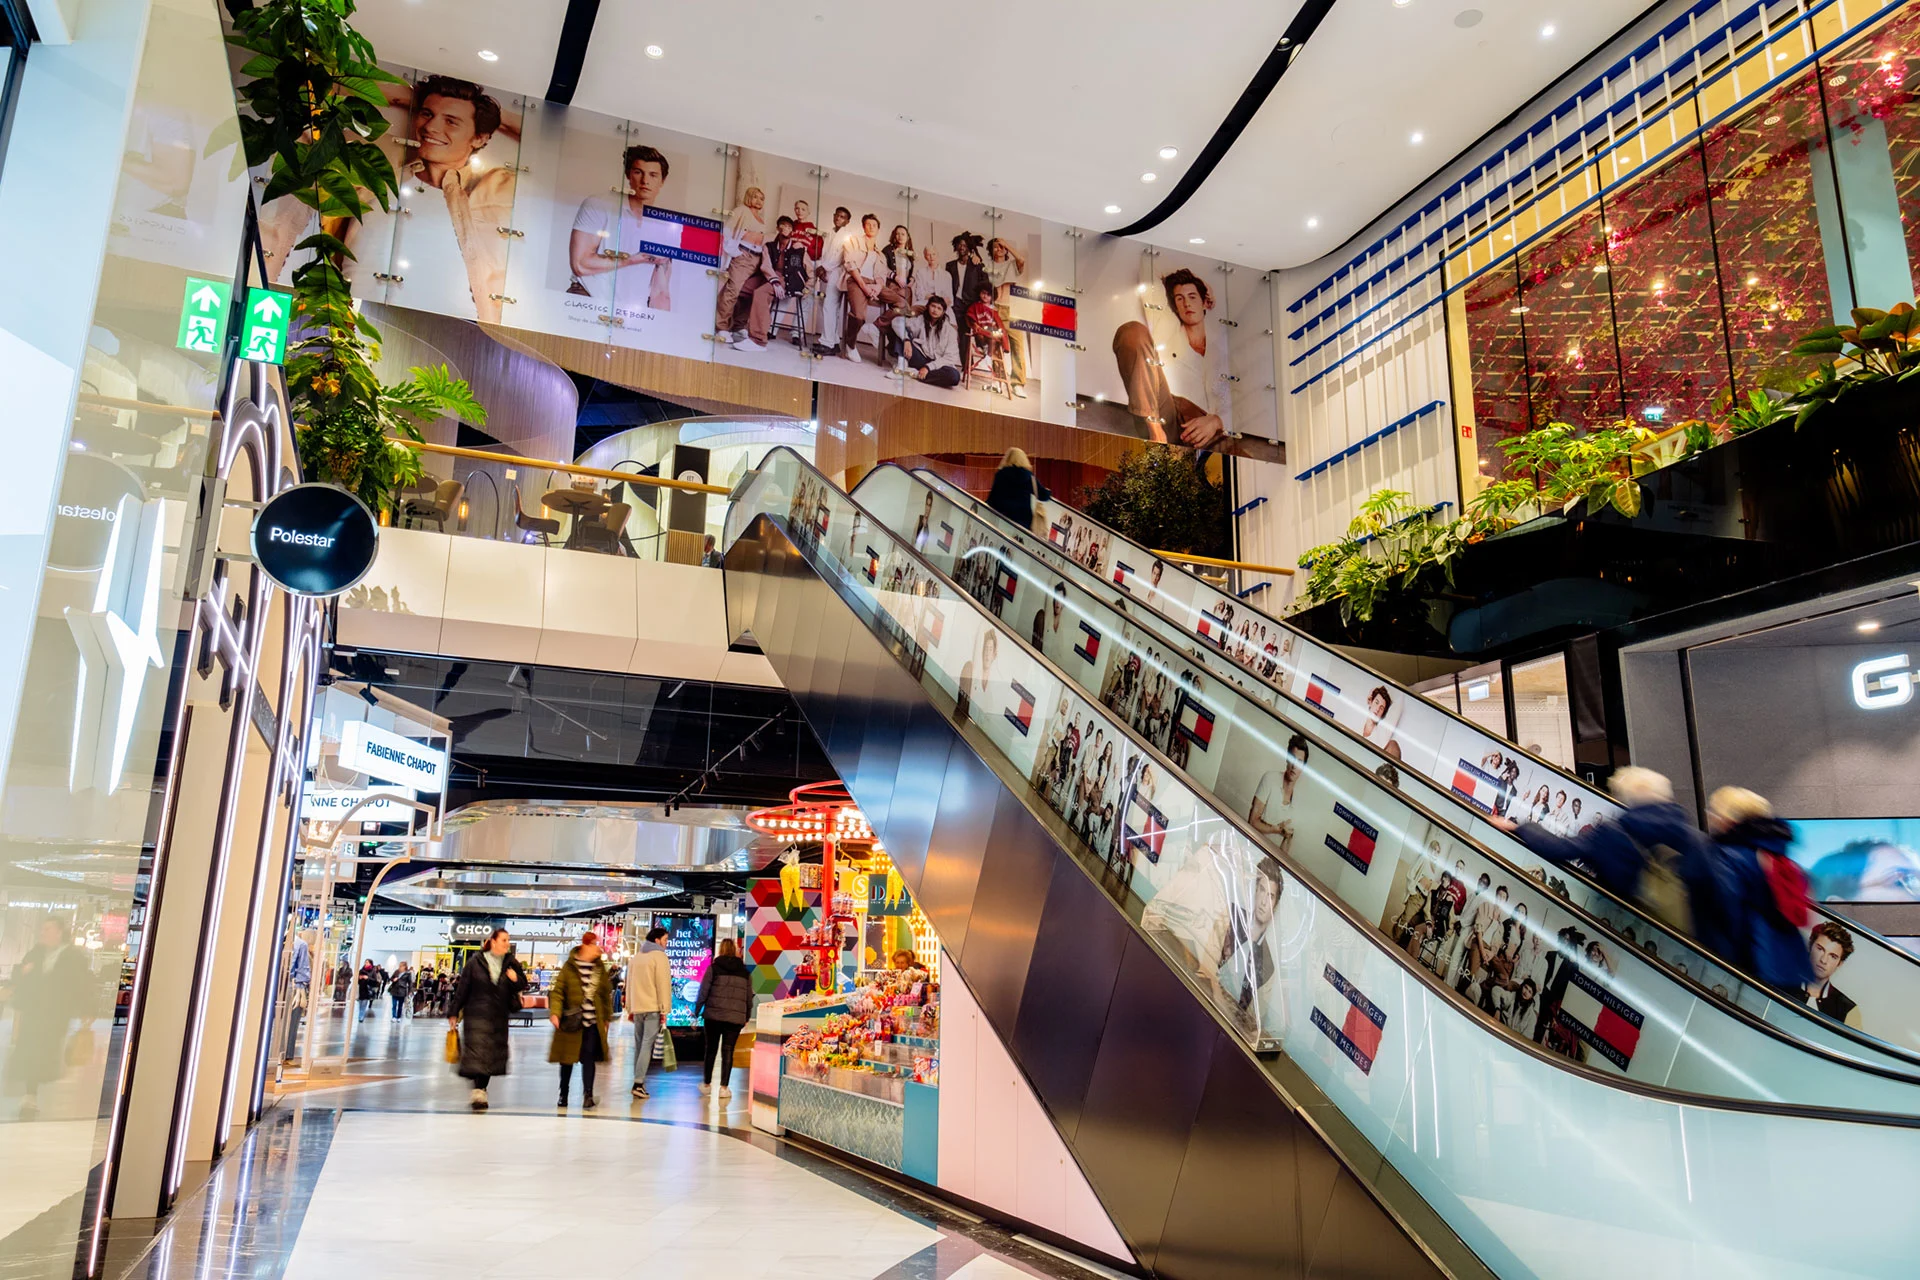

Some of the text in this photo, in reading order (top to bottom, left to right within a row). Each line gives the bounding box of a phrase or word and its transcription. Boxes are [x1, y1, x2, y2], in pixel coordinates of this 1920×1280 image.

[645, 207, 721, 230] TOMMY HILFIGER
[643, 243, 718, 265] SHAWN MENDES
[564, 300, 655, 321] CLASSICS REBORN
[1041, 294, 1074, 306] HILFIGER
[1012, 321, 1074, 339] SHAWN MENDES
[270, 527, 335, 548] Polestar
[1852, 654, 1920, 710] G
[366, 741, 437, 775] FABIENNE CHAPOT
[341, 796, 390, 808] CHPOT
[1335, 805, 1376, 838] TOMMY HILFIGER
[1326, 837, 1367, 871] SHAWN MENDES
[456, 925, 492, 935] CHCO
[676, 929, 692, 938] het
[666, 938, 700, 948] nieuwe
[1326, 967, 1383, 1024] TOMMY HILFIGER
[1574, 973, 1640, 1024] TOMMY HILFIGER
[1313, 1012, 1368, 1069] SHAWN MENDES
[1561, 1013, 1625, 1066] SHAWN MENDES
